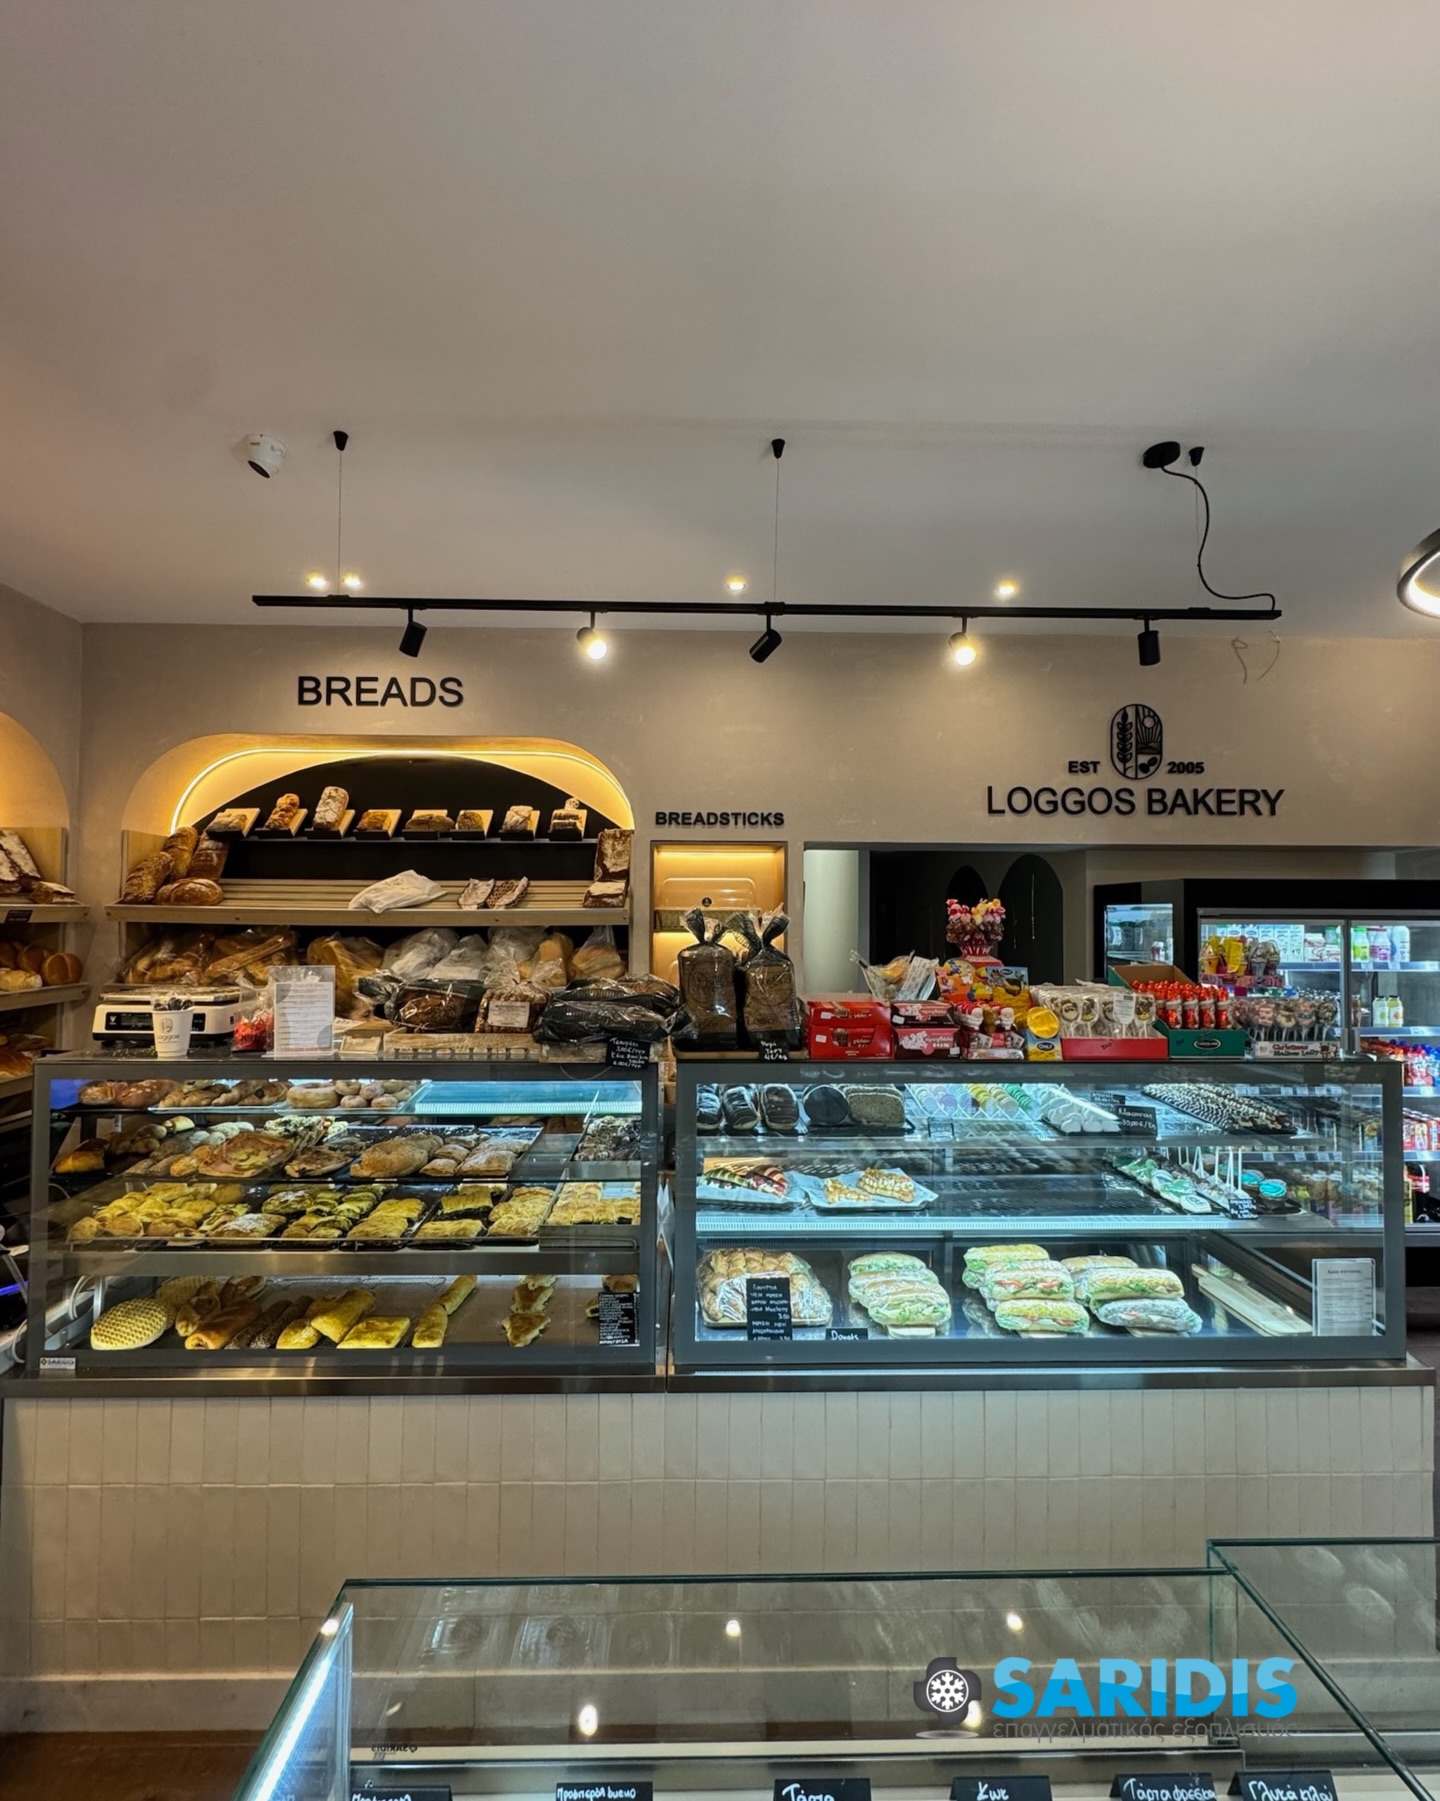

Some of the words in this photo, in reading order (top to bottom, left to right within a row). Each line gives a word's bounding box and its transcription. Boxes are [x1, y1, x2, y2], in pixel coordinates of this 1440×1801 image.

[297, 675, 464, 708] BREADS
[1068, 761, 1100, 774] EST
[1167, 761, 1205, 774] 2005
[986, 785, 1136, 816] LOGGOS
[1146, 787, 1285, 817] BAKERY
[655, 811, 785, 826] BREADSTICKS
[607, 1786, 637, 1799] bueno
